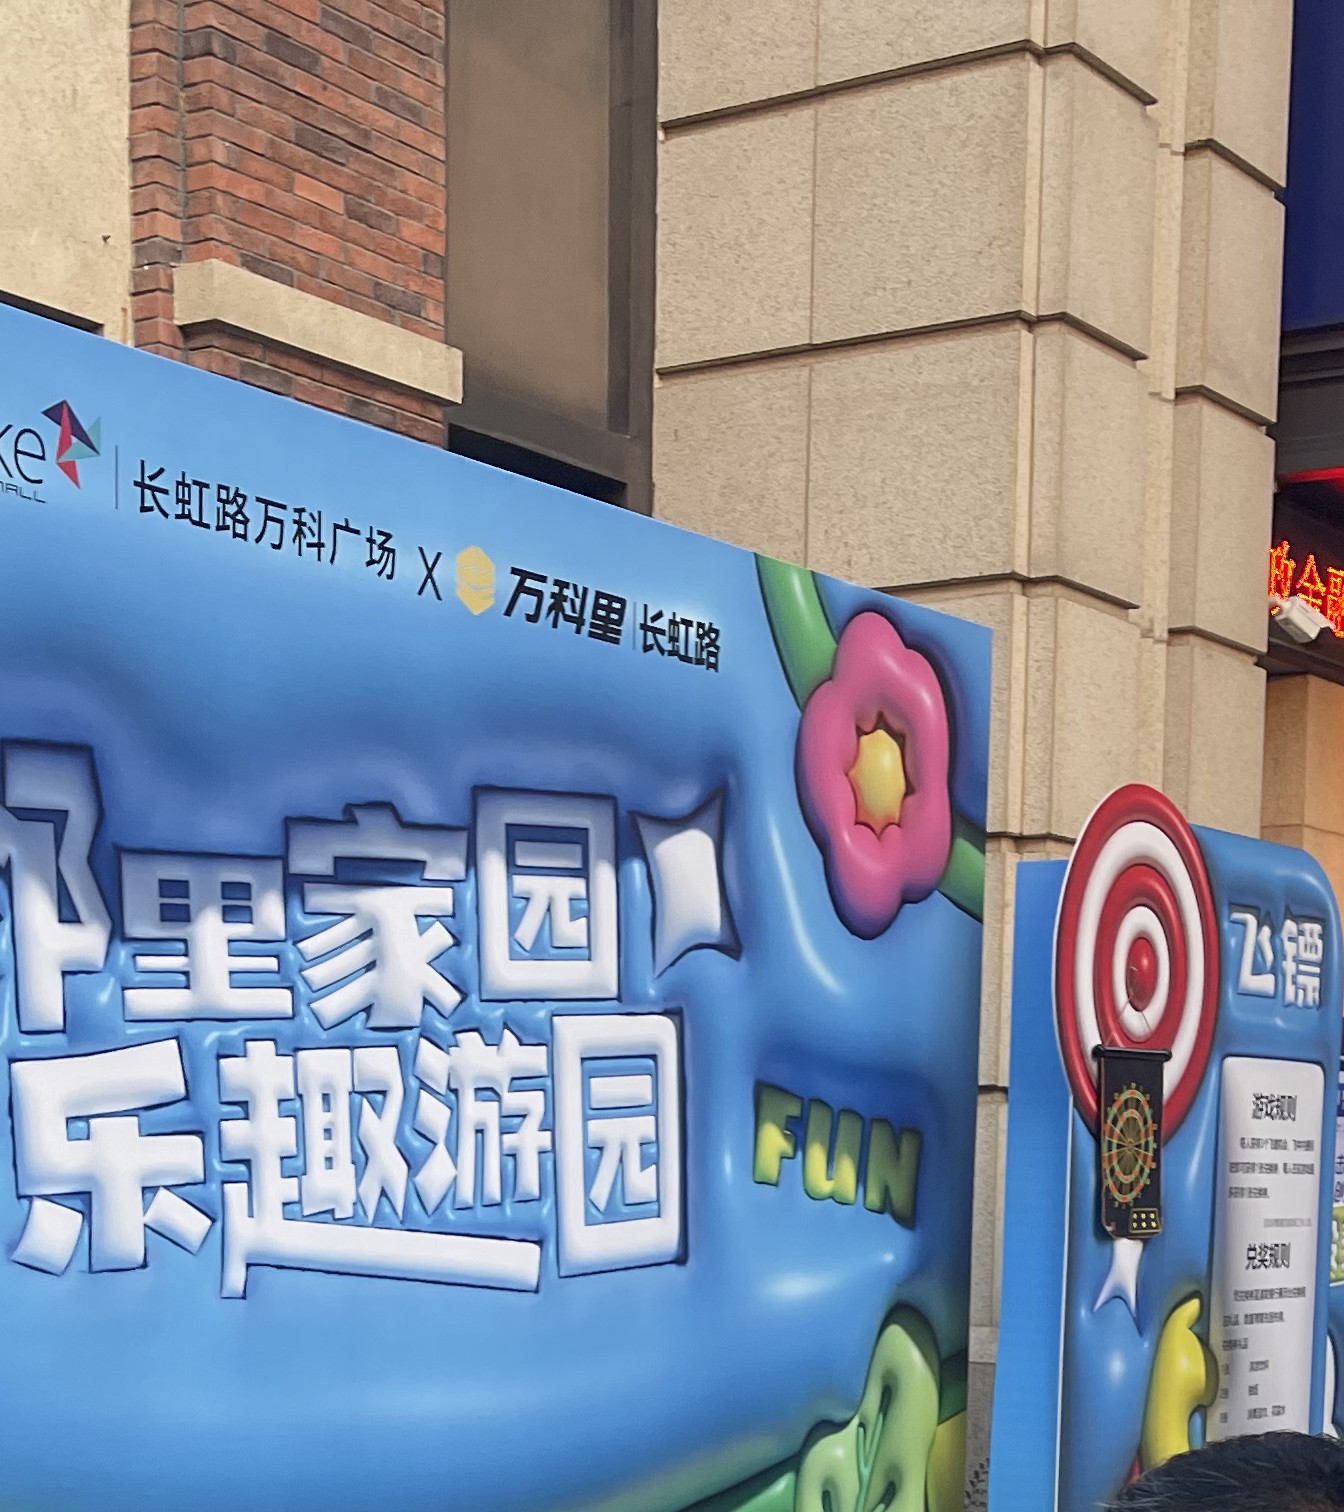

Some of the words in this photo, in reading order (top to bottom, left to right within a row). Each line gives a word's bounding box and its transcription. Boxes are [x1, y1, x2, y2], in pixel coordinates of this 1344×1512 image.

[133, 459, 398, 582] 长虹路万科广场
[503, 566, 627, 647] 万科里
[638, 603, 722, 673] 长虹路
[1229, 910, 1325, 1010] 飞镖
[9, 1007, 686, 1298] 乐趣游园
[752, 1079, 923, 1229] FUN
[1245, 1242, 1292, 1271] 兑奖规则
